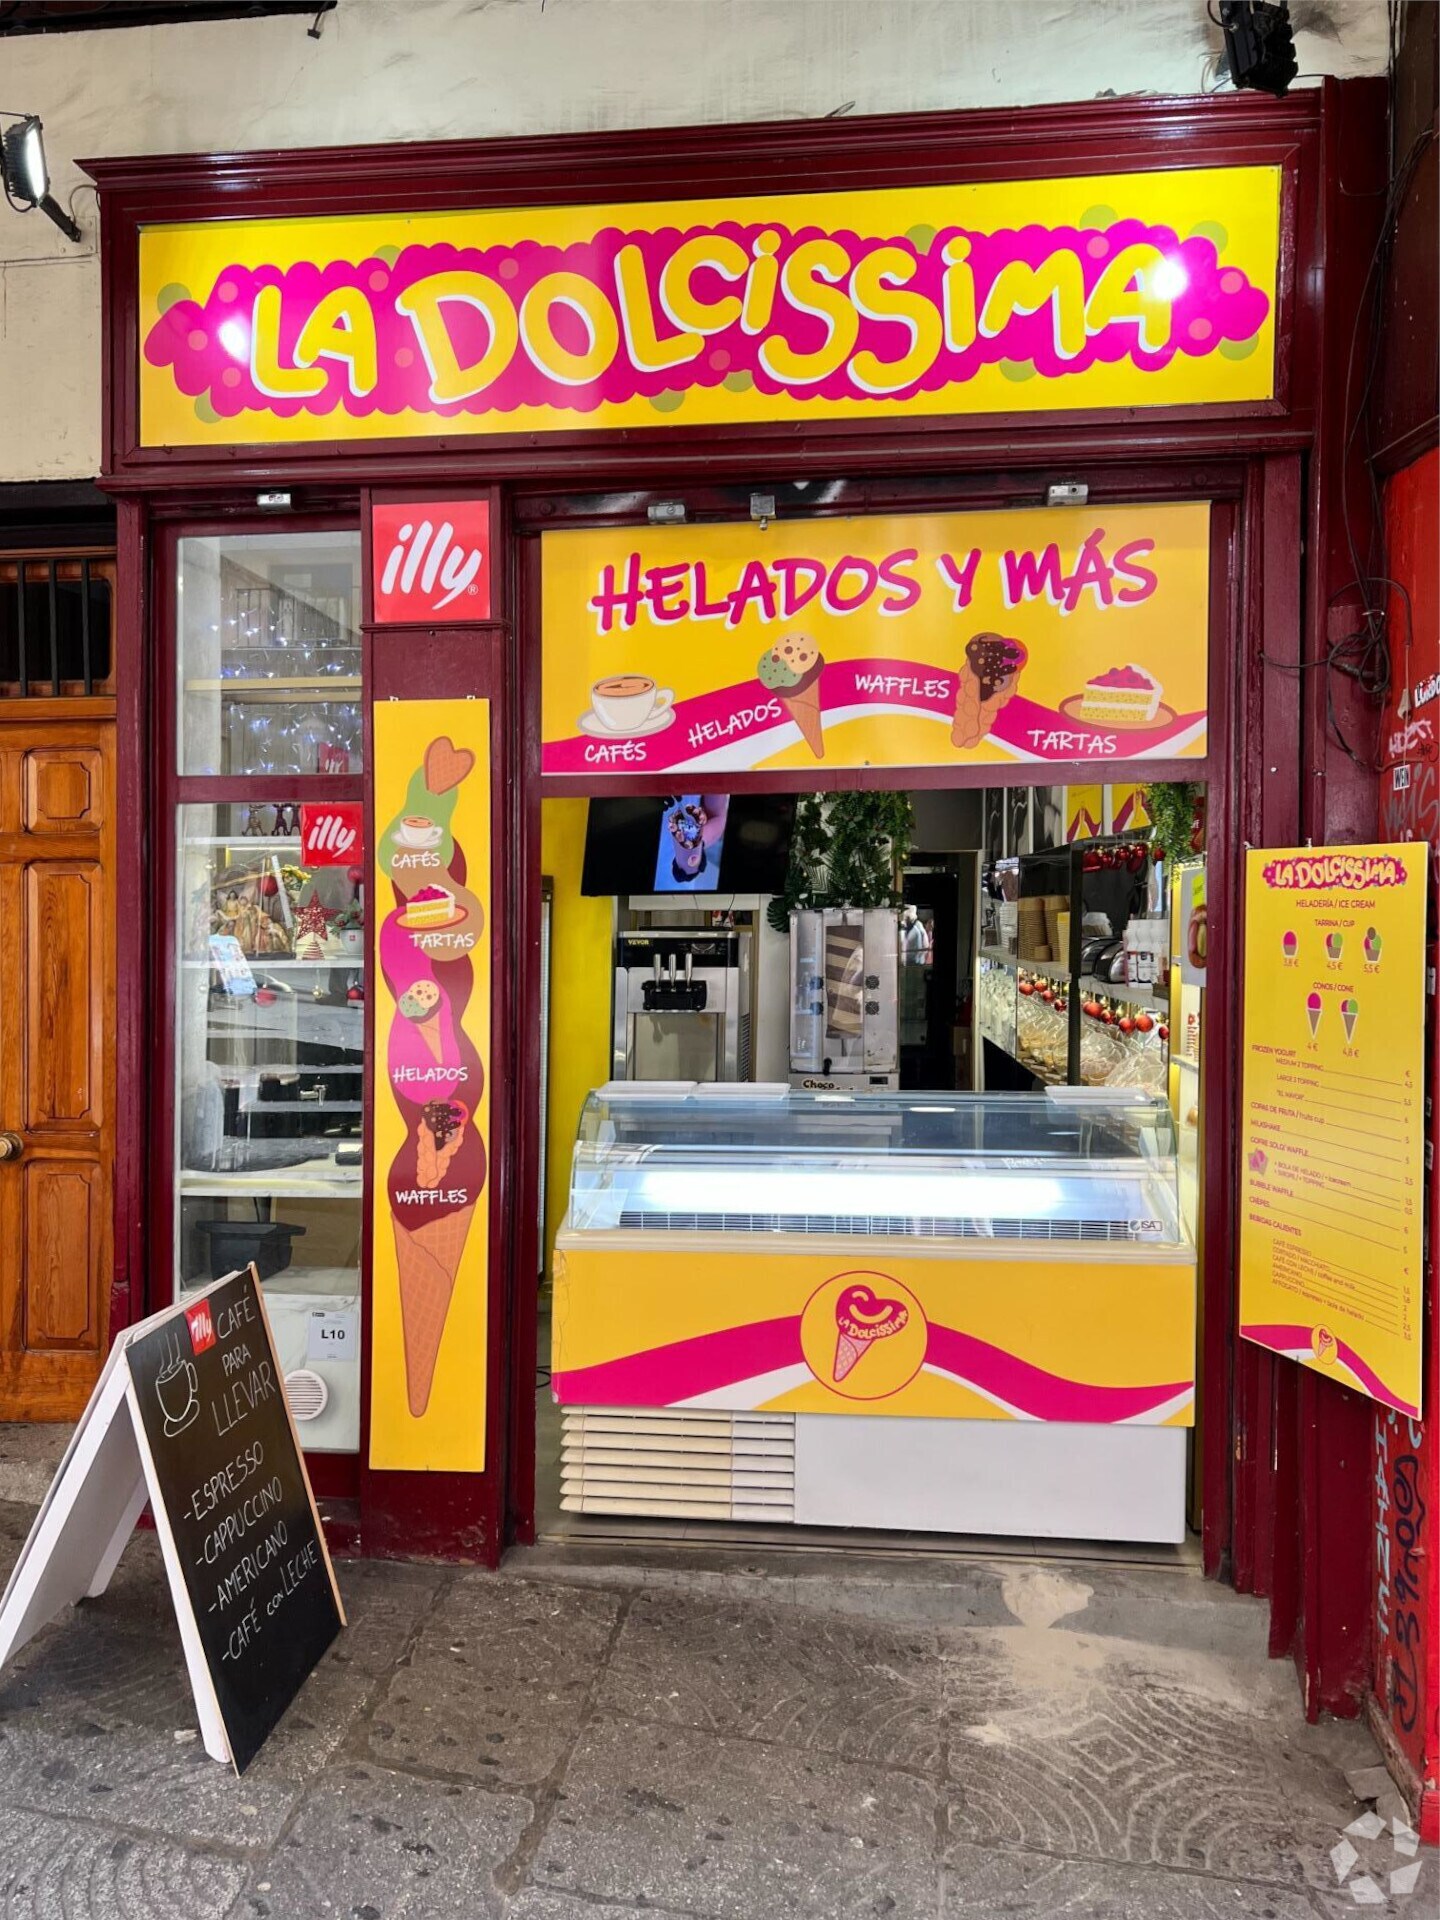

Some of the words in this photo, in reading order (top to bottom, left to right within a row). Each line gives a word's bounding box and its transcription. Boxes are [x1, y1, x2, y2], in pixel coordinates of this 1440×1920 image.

[249, 284, 378, 398] LA
[587, 548, 922, 635] HELADOS
[937, 548, 982, 614] Y
[1000, 527, 1158, 618] MÁS
[855, 674, 951, 699] WAFFLES
[687, 698, 783, 749] HELADOS
[584, 741, 647, 763] CAFÉS
[1026, 730, 1118, 755] TARTAS
[307, 815, 357, 858] illy
[391, 852, 441, 869] CAFÉS
[1275, 863, 1294, 886] LA
[1339, 900, 1350, 908] ICE
[1351, 900, 1376, 909] CREAM
[409, 932, 474, 949] TARTAS
[392, 1066, 469, 1083] HELADOS
[802, 1079, 835, 1090] Choco
[395, 1190, 468, 1205] WAFFLES
[216, 1284, 256, 1340] CAFÉ
[838, 1316, 849, 1328] LA
[321, 1328, 345, 1340] L10
[221, 1343, 252, 1377] PARA
[211, 1360, 276, 1436] LLEVAR
[280, 1539, 318, 1597] LECHE
